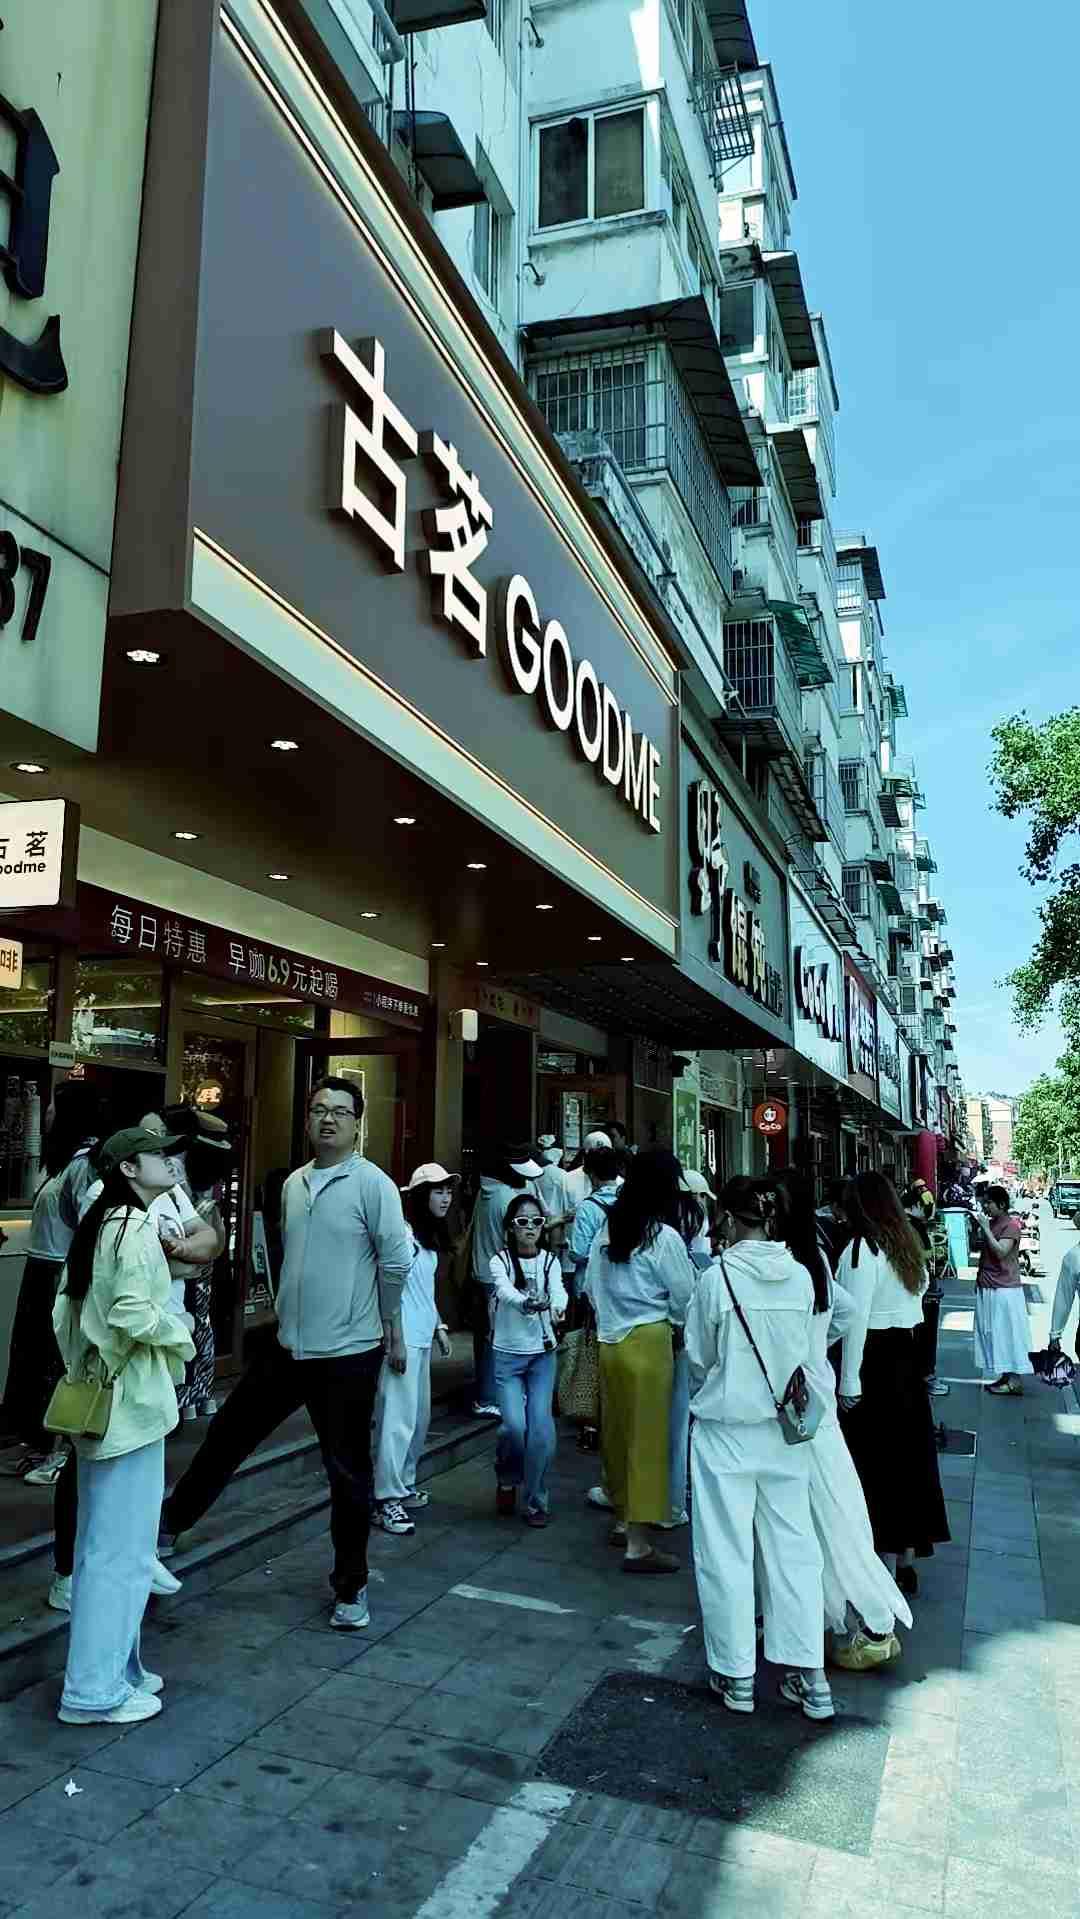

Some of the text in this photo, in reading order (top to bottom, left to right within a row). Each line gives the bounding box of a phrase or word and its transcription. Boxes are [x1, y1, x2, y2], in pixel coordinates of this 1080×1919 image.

[321, 327, 662, 834] 古茗 GOODME
[110, 904, 208, 964] 每日特惠
[759, 1122, 782, 1131] CoCo
